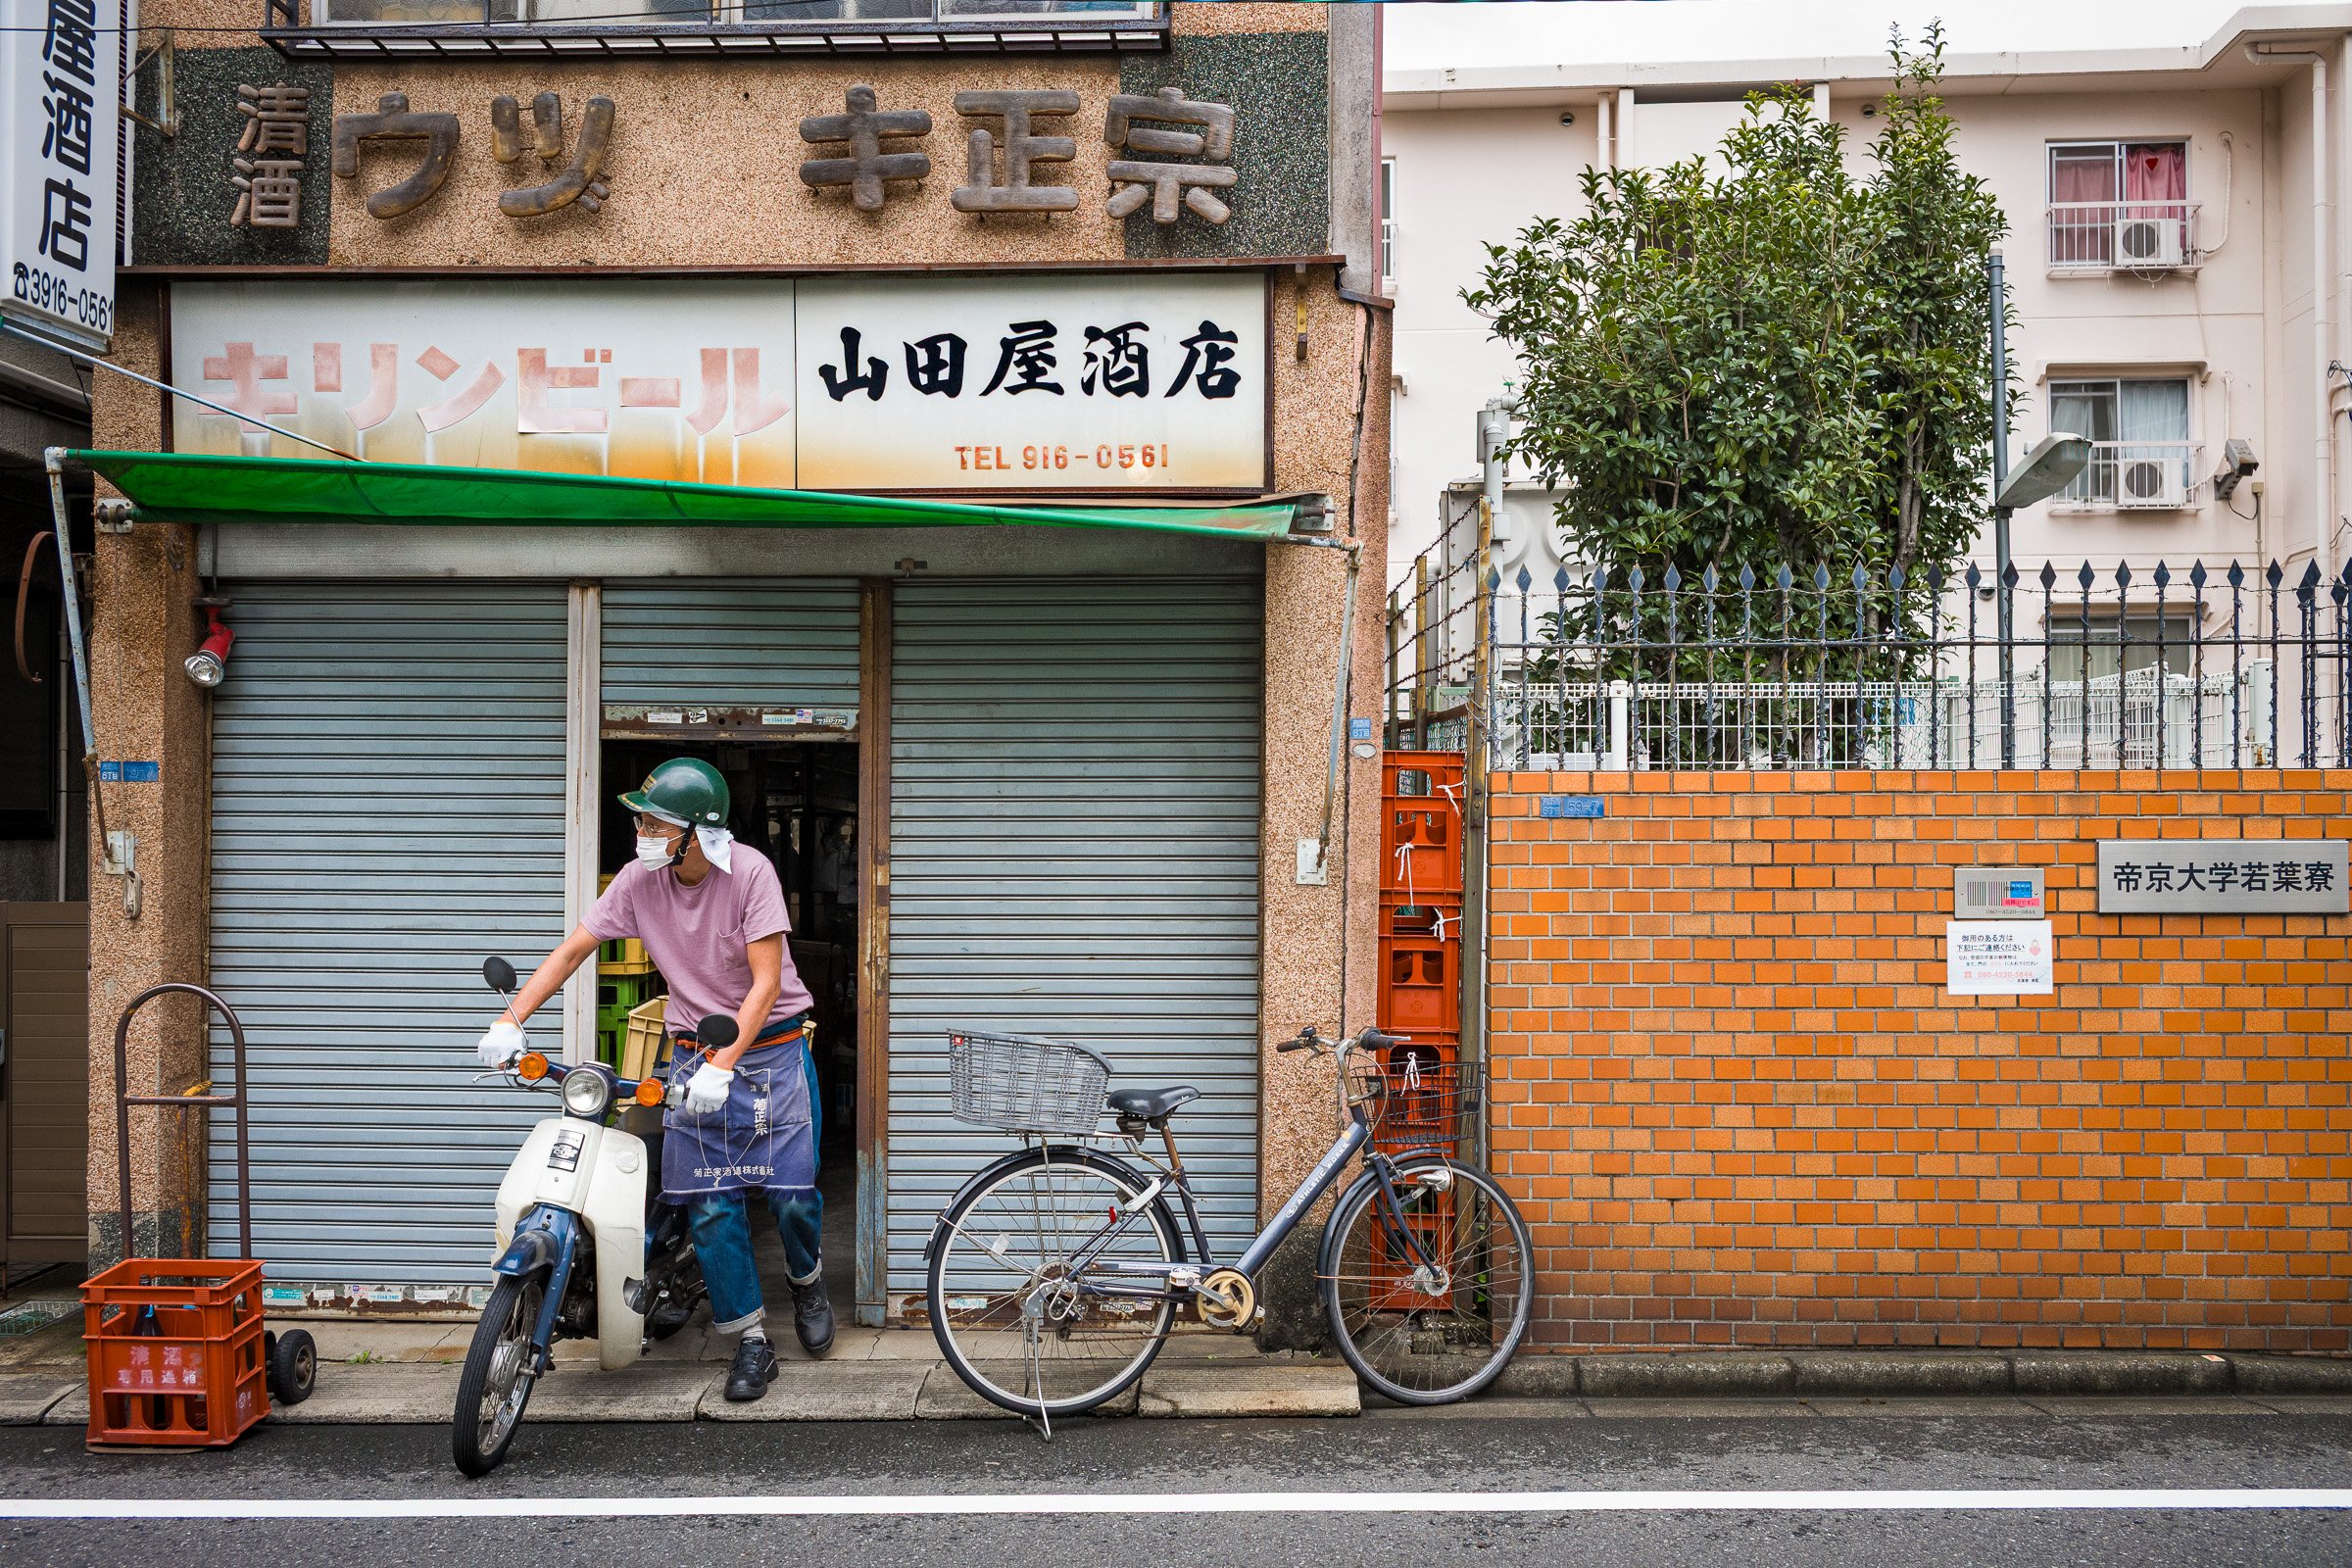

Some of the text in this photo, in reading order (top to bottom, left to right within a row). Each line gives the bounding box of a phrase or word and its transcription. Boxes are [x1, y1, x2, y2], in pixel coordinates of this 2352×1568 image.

[230, 82, 310, 227] 清酒
[30, 268, 114, 334] 3916-0561
[198, 342, 791, 435] キリンビール
[818, 319, 1242, 402] 山田屋酒店
[955, 444, 1169, 470] TEL 916-0561
[1568, 800, 1600, 814] 59-7
[2113, 861, 2334, 893] 帝京大学若葉寮
[753, 1098, 768, 1136] 菊正宗
[1297, 1142, 1351, 1205] ATHLETIC WORKS
